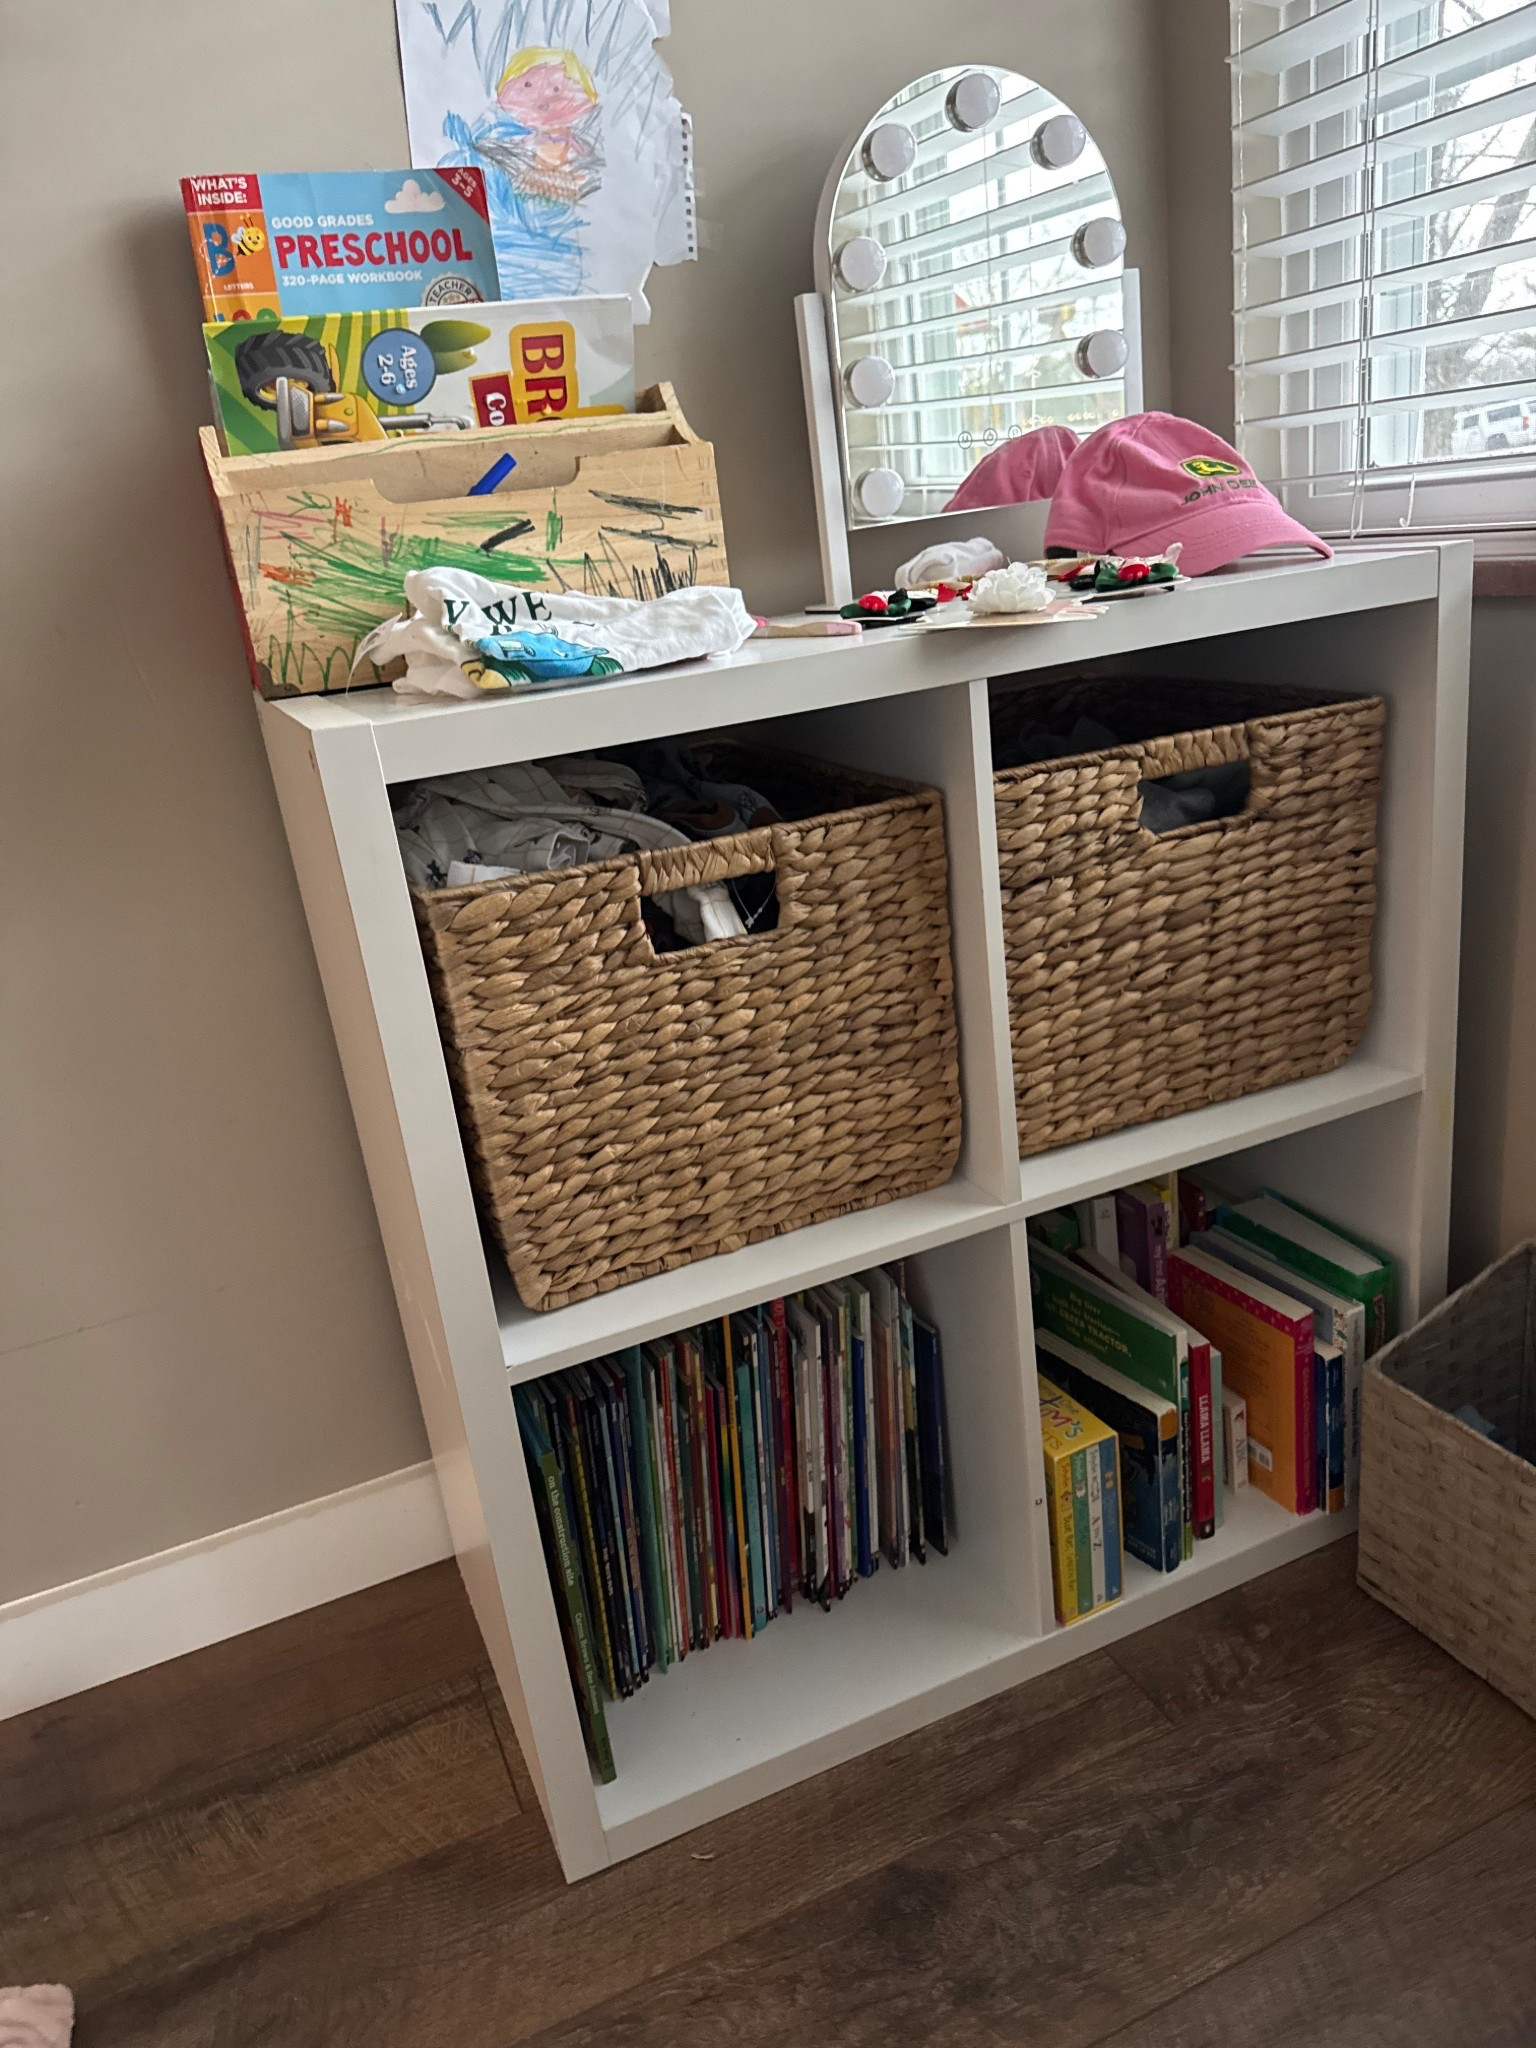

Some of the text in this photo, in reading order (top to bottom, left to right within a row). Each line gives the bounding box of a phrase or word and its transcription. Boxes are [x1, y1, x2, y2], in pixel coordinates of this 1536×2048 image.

[191, 177, 248, 192] WHAT'S
[456, 168, 477, 188] AGES
[197, 191, 248, 206] INSIDE:
[271, 213, 374, 230] GOOD GRADES
[273, 227, 474, 269] PRESCHOOL
[223, 281, 255, 292] LETTERS
[281, 269, 423, 288] 320-PAGE WORKBOOK
[429, 280, 472, 303] TEACHER
[378, 353, 397, 385] 2-6
[400, 345, 418, 389] Ages
[521, 334, 568, 422] BR
[1198, 1393, 1209, 1428] LLAMA
[1200, 1429, 1211, 1464] LLAMA
[547, 1475, 576, 1587] on the construction site
